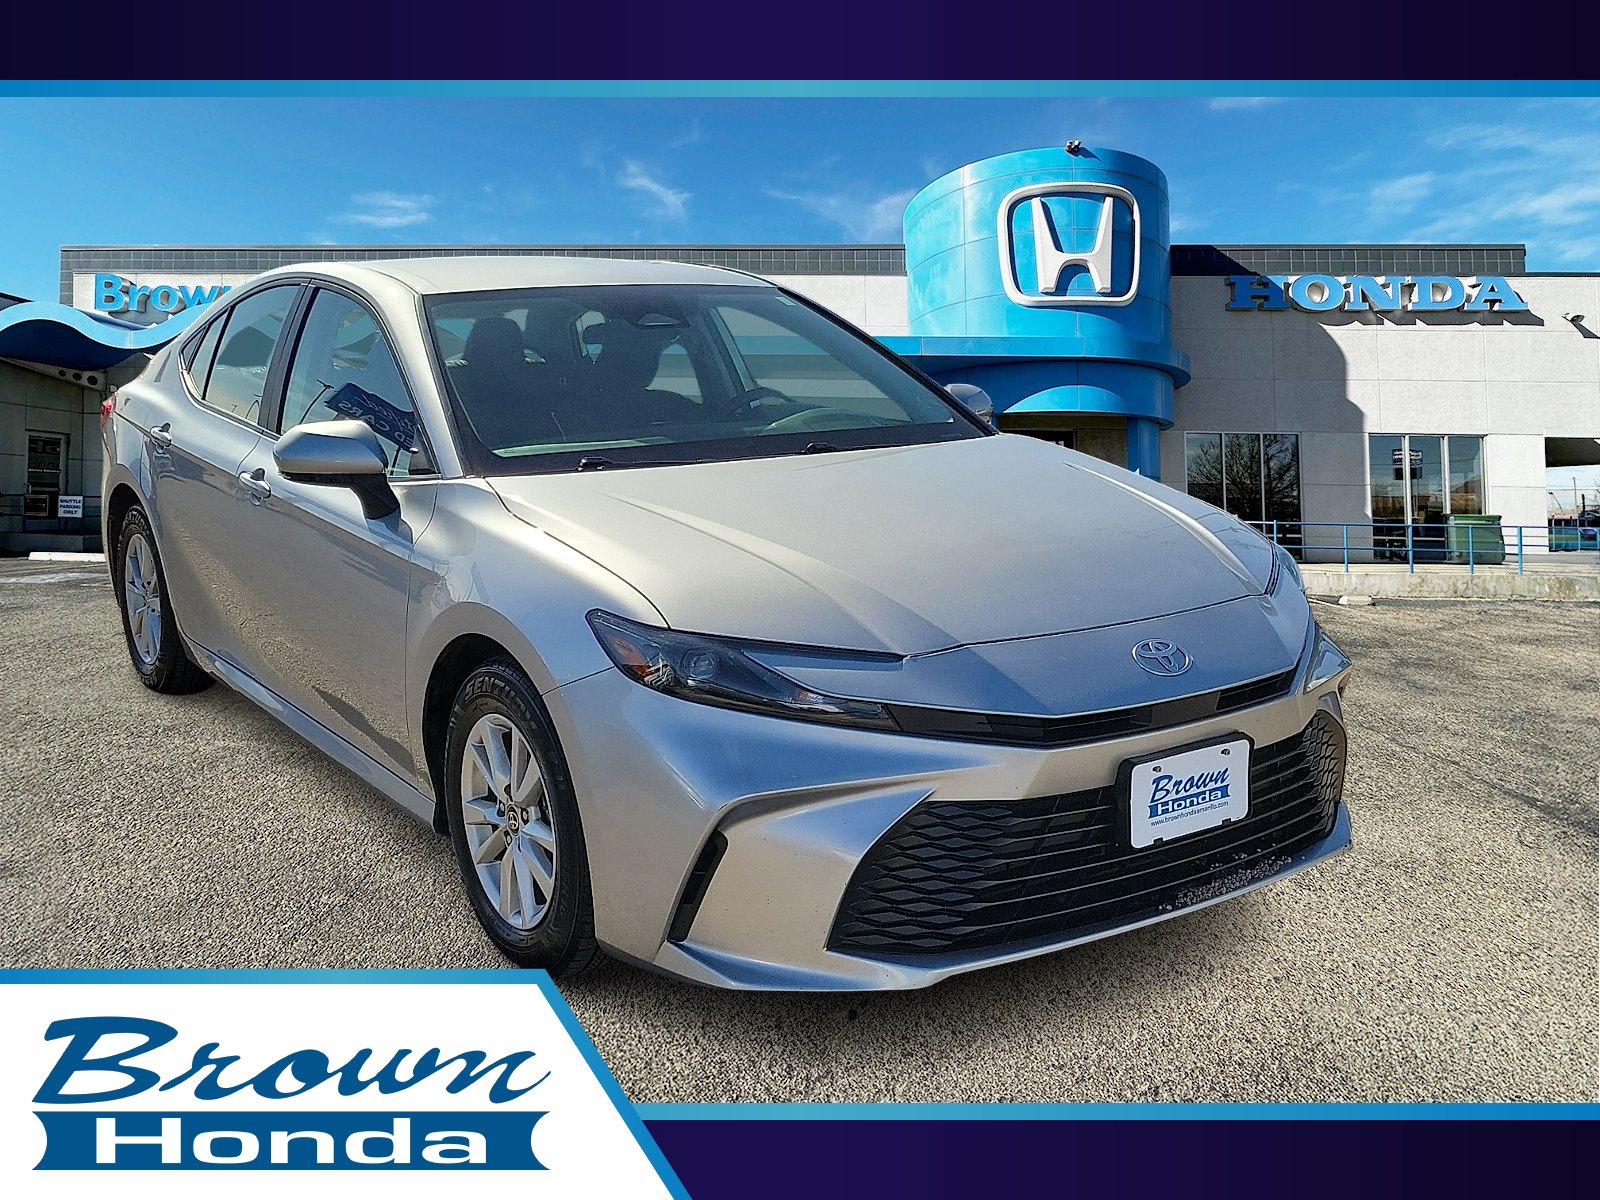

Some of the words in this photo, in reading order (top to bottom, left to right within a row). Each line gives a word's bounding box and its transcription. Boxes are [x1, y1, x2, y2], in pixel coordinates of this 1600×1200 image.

[95, 272, 231, 311] Brow
[1226, 273, 1529, 312] HONDA
[1150, 767, 1229, 803] Brown
[1157, 790, 1222, 816] Honda
